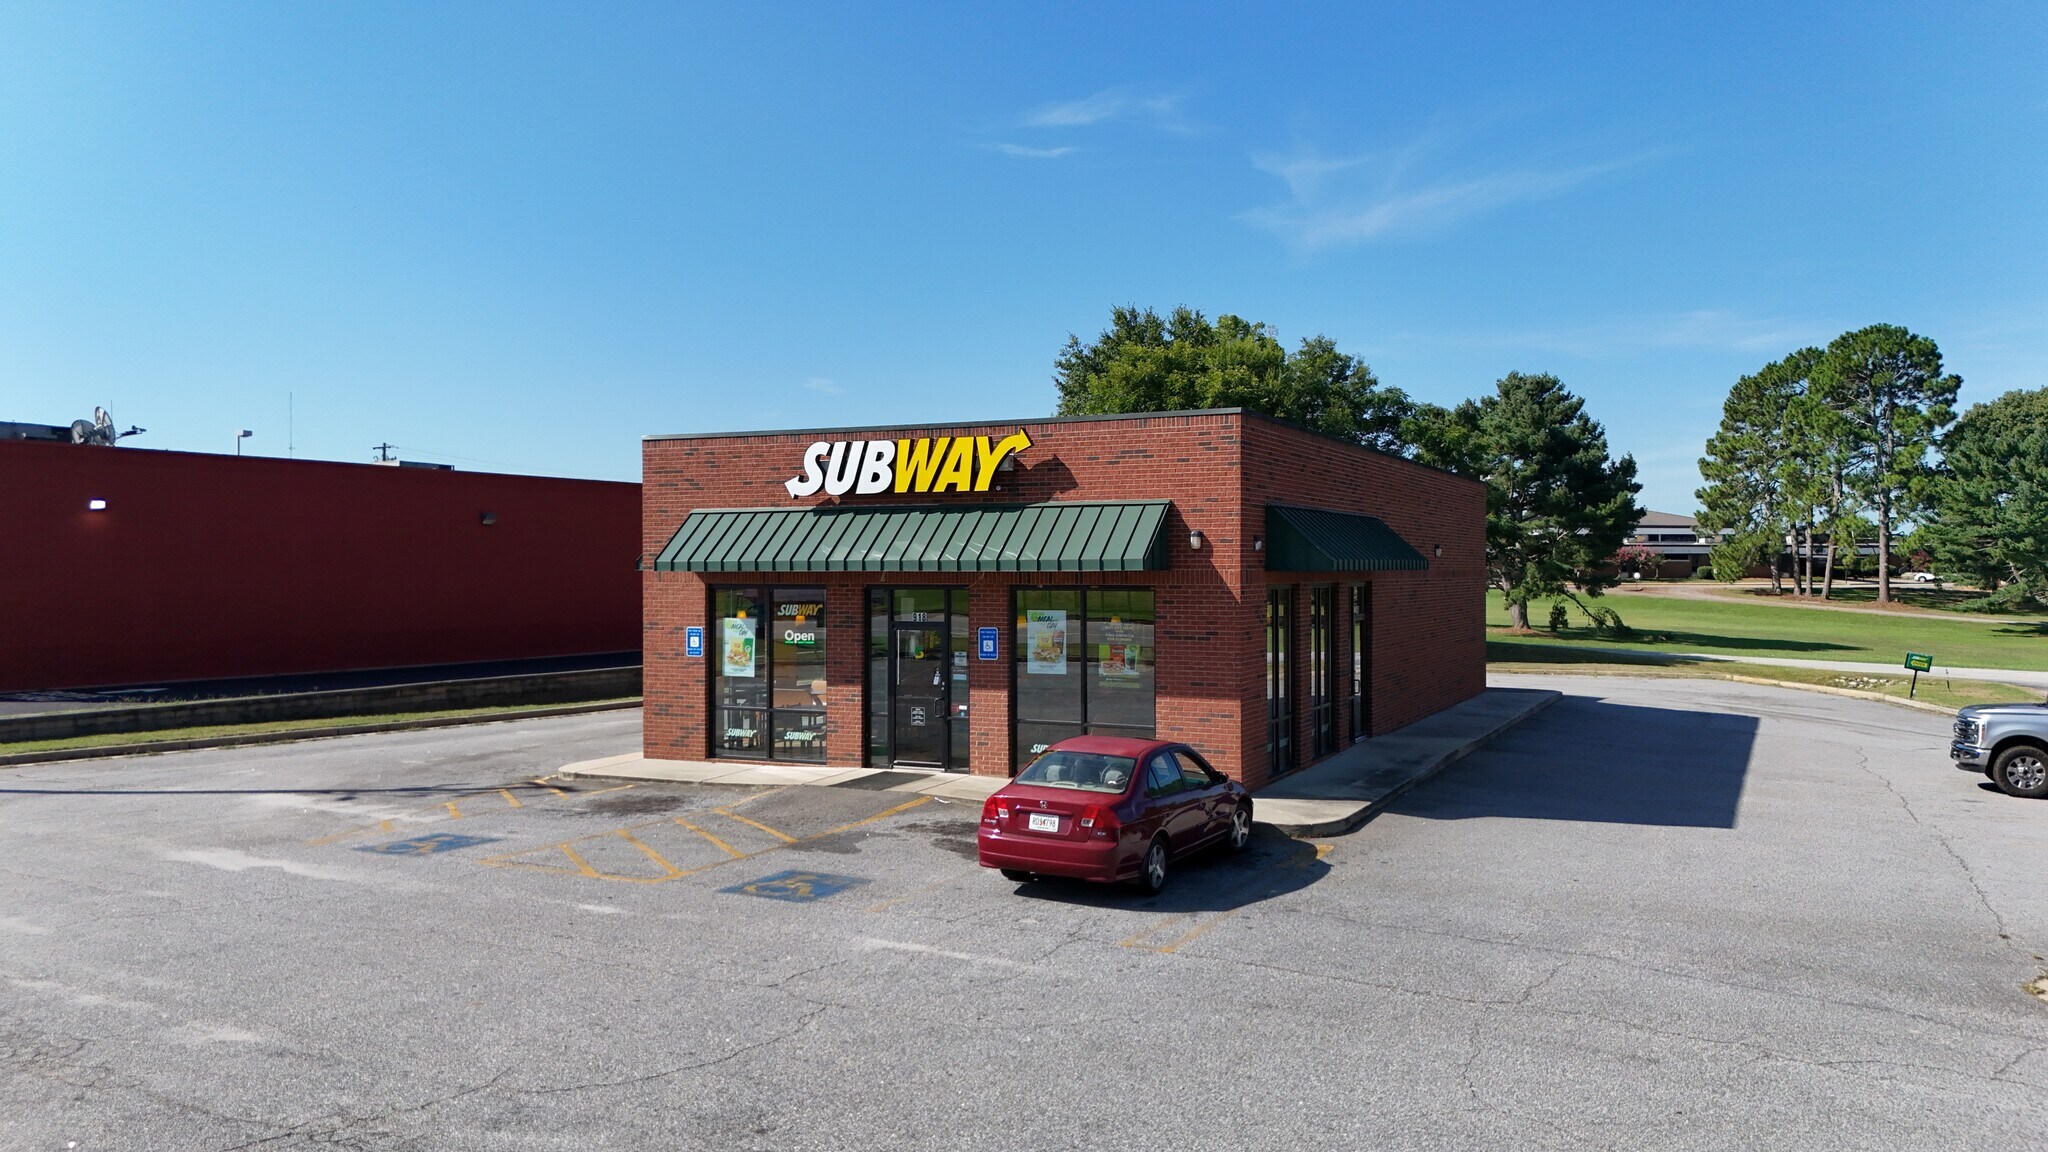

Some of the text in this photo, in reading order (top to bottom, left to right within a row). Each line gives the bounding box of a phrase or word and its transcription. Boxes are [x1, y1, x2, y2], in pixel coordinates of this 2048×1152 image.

[784, 428, 1032, 499] SUBWAY
[777, 604, 824, 616] SUBWAY
[912, 612, 928, 622] 918
[785, 630, 815, 643] Open
[726, 728, 757, 738] SUBWAY
[784, 732, 816, 741] SUBWAY
